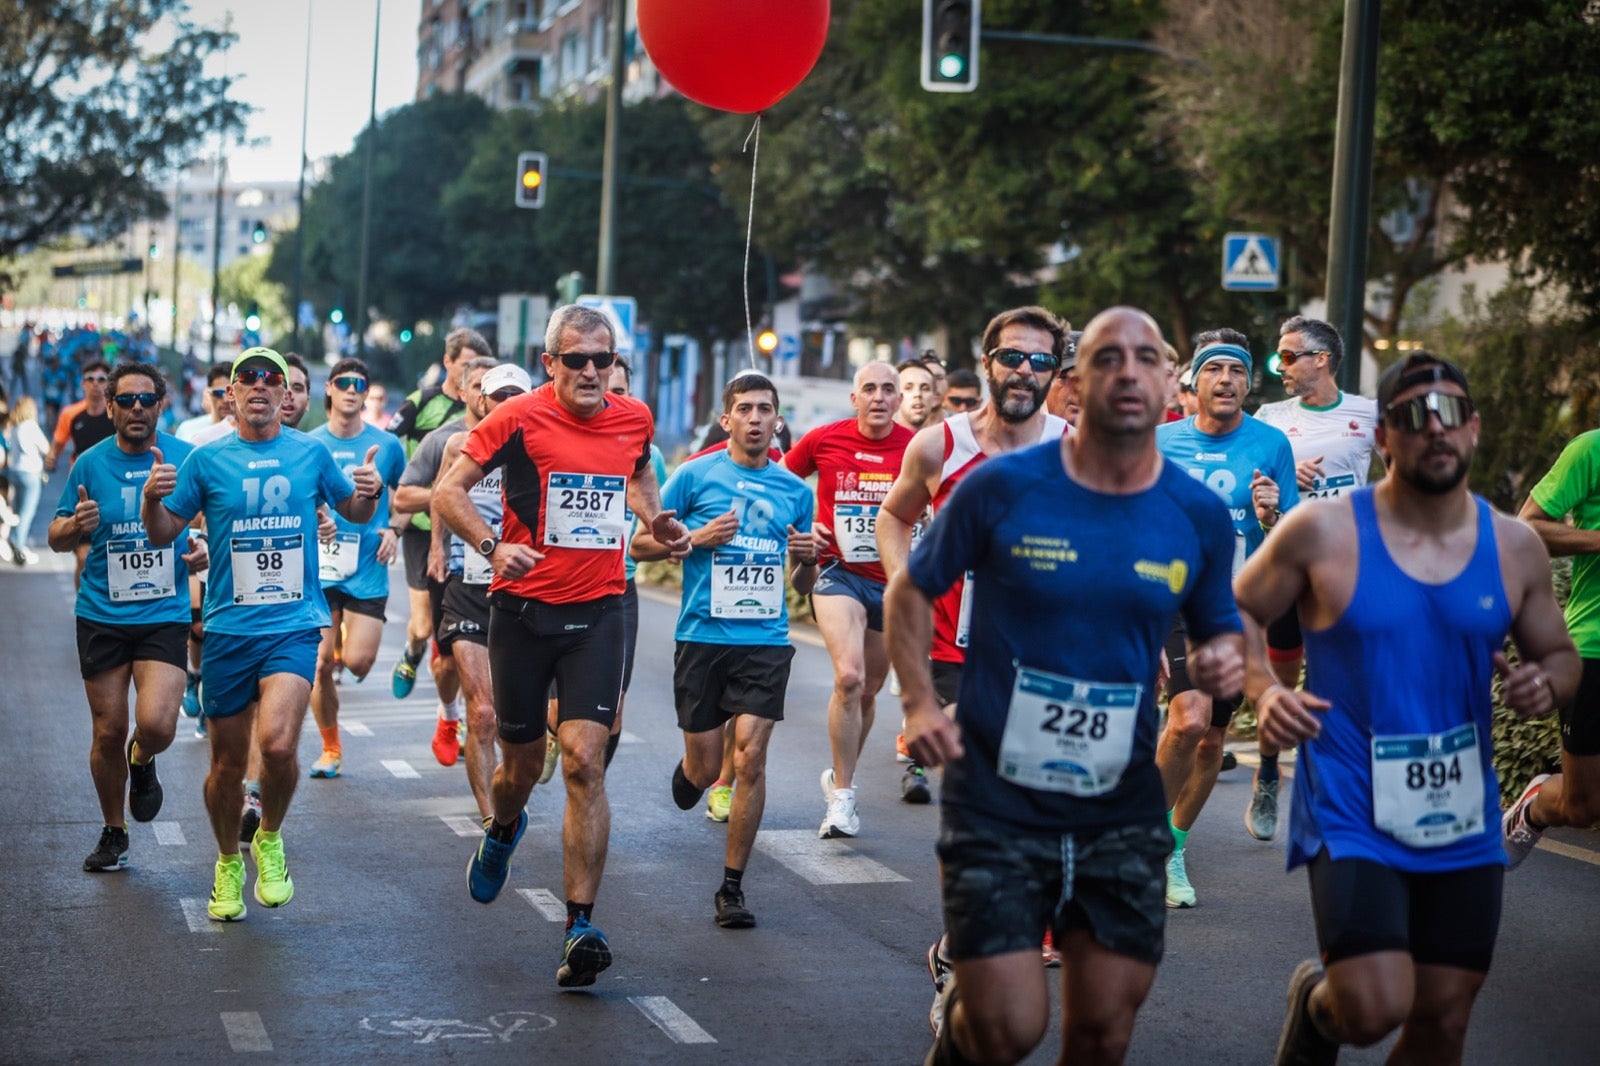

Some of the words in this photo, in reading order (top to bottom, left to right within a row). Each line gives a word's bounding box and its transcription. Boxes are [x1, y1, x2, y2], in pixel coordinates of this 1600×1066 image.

[242, 475, 291, 516] 18
[858, 481, 893, 493] PADRE
[560, 489, 614, 512] 2587
[232, 515, 301, 533] MARCELINO
[568, 511, 583, 519] JOSE
[731, 496, 774, 535] 18
[119, 551, 163, 570] 1051
[256, 552, 283, 571] 98
[725, 566, 775, 585] 1476
[1041, 704, 1109, 741] 228
[1406, 755, 1462, 790] 894
